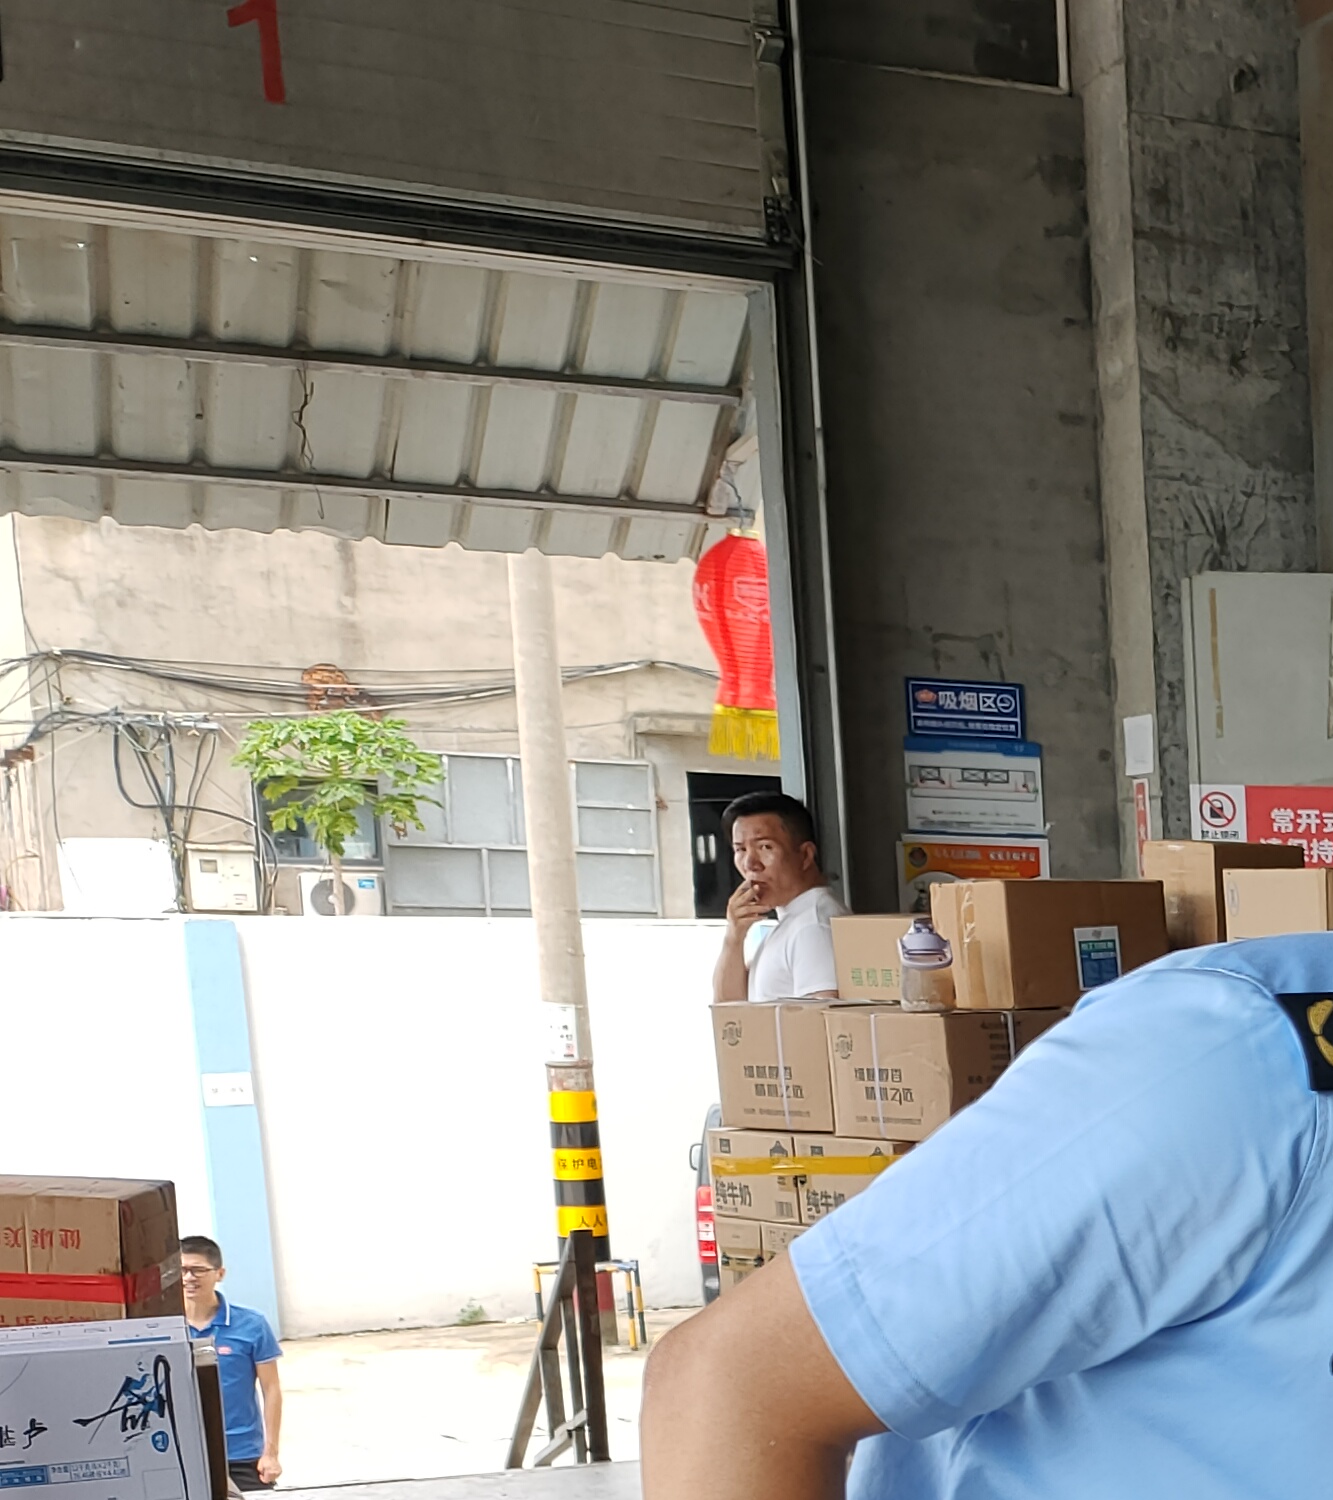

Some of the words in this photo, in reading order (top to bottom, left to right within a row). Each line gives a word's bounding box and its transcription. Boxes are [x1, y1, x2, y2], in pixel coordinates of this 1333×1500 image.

[938, 691, 999, 713] 吸烟区
[558, 1157, 601, 1171] 保护电
[715, 1179, 752, 1208] 纯牛奶
